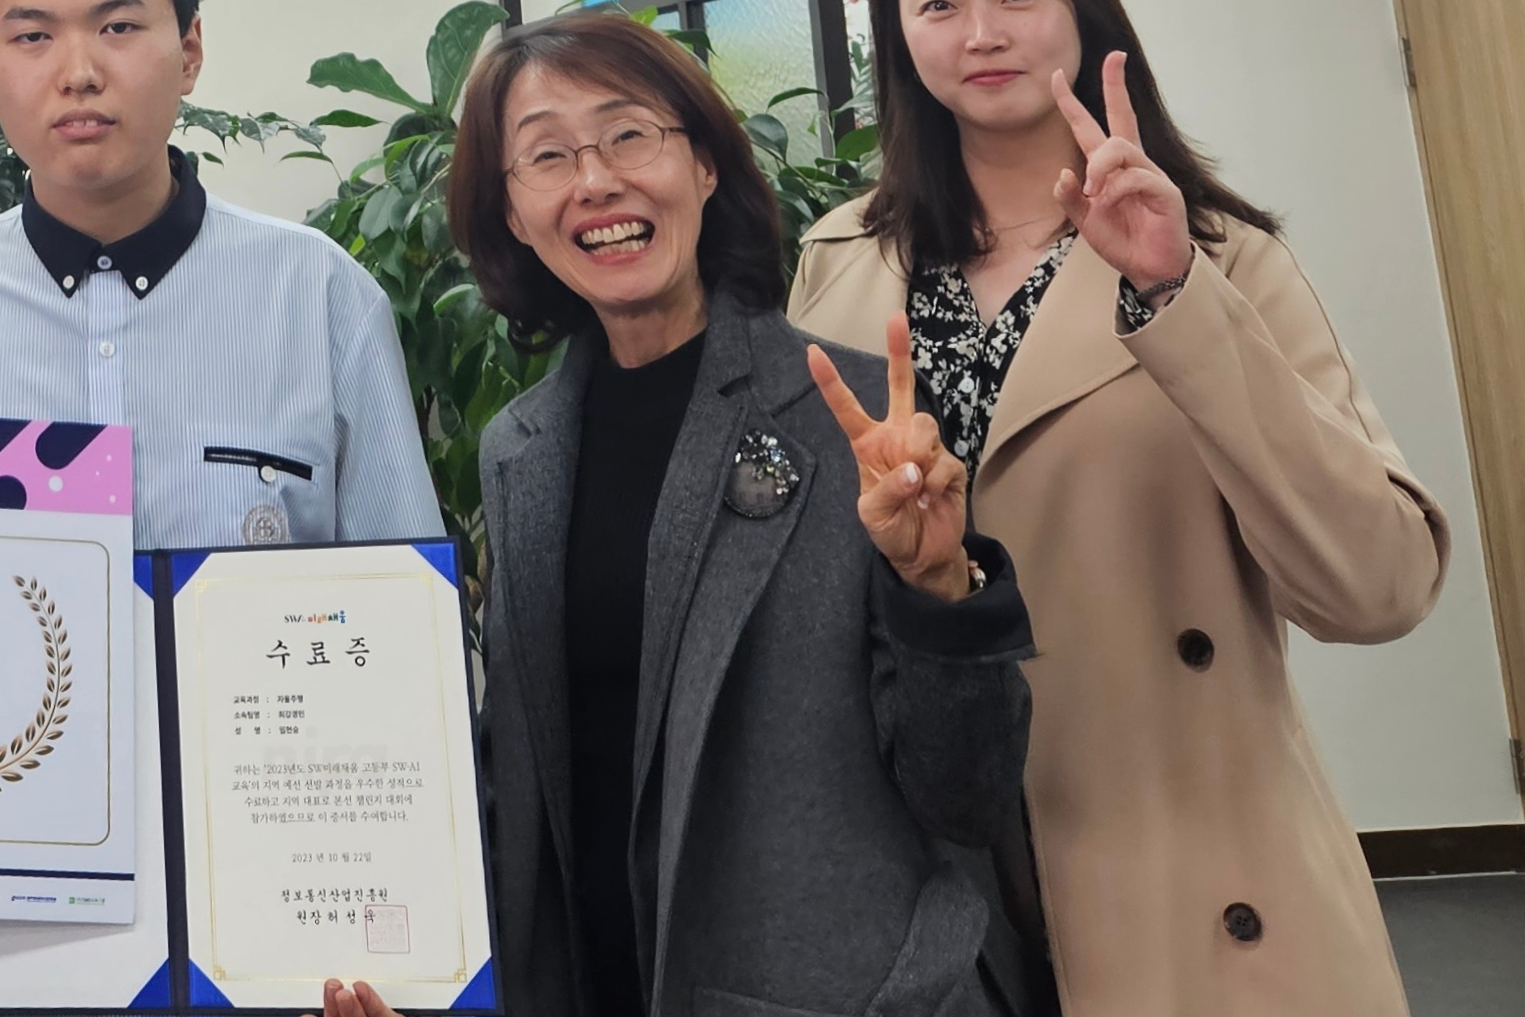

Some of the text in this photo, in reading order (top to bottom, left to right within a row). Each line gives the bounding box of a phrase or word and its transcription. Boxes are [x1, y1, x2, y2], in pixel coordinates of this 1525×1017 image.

[234, 764, 261, 775] 귀하는
[361, 762, 389, 773] 고등부
[263, 780, 280, 791] 지역
[356, 778, 384, 789] 우수한
[244, 796, 280, 807] 수료하고
[282, 796, 300, 807] 지역
[303, 795, 331, 806] 대표로
[386, 793, 413, 805] 대회에
[251, 812, 316, 824] 참가하였으므로
[318, 811, 328, 823] 이
[292, 852, 313, 863] 2023
[329, 852, 338, 862] 10
[297, 909, 322, 925] 원장
